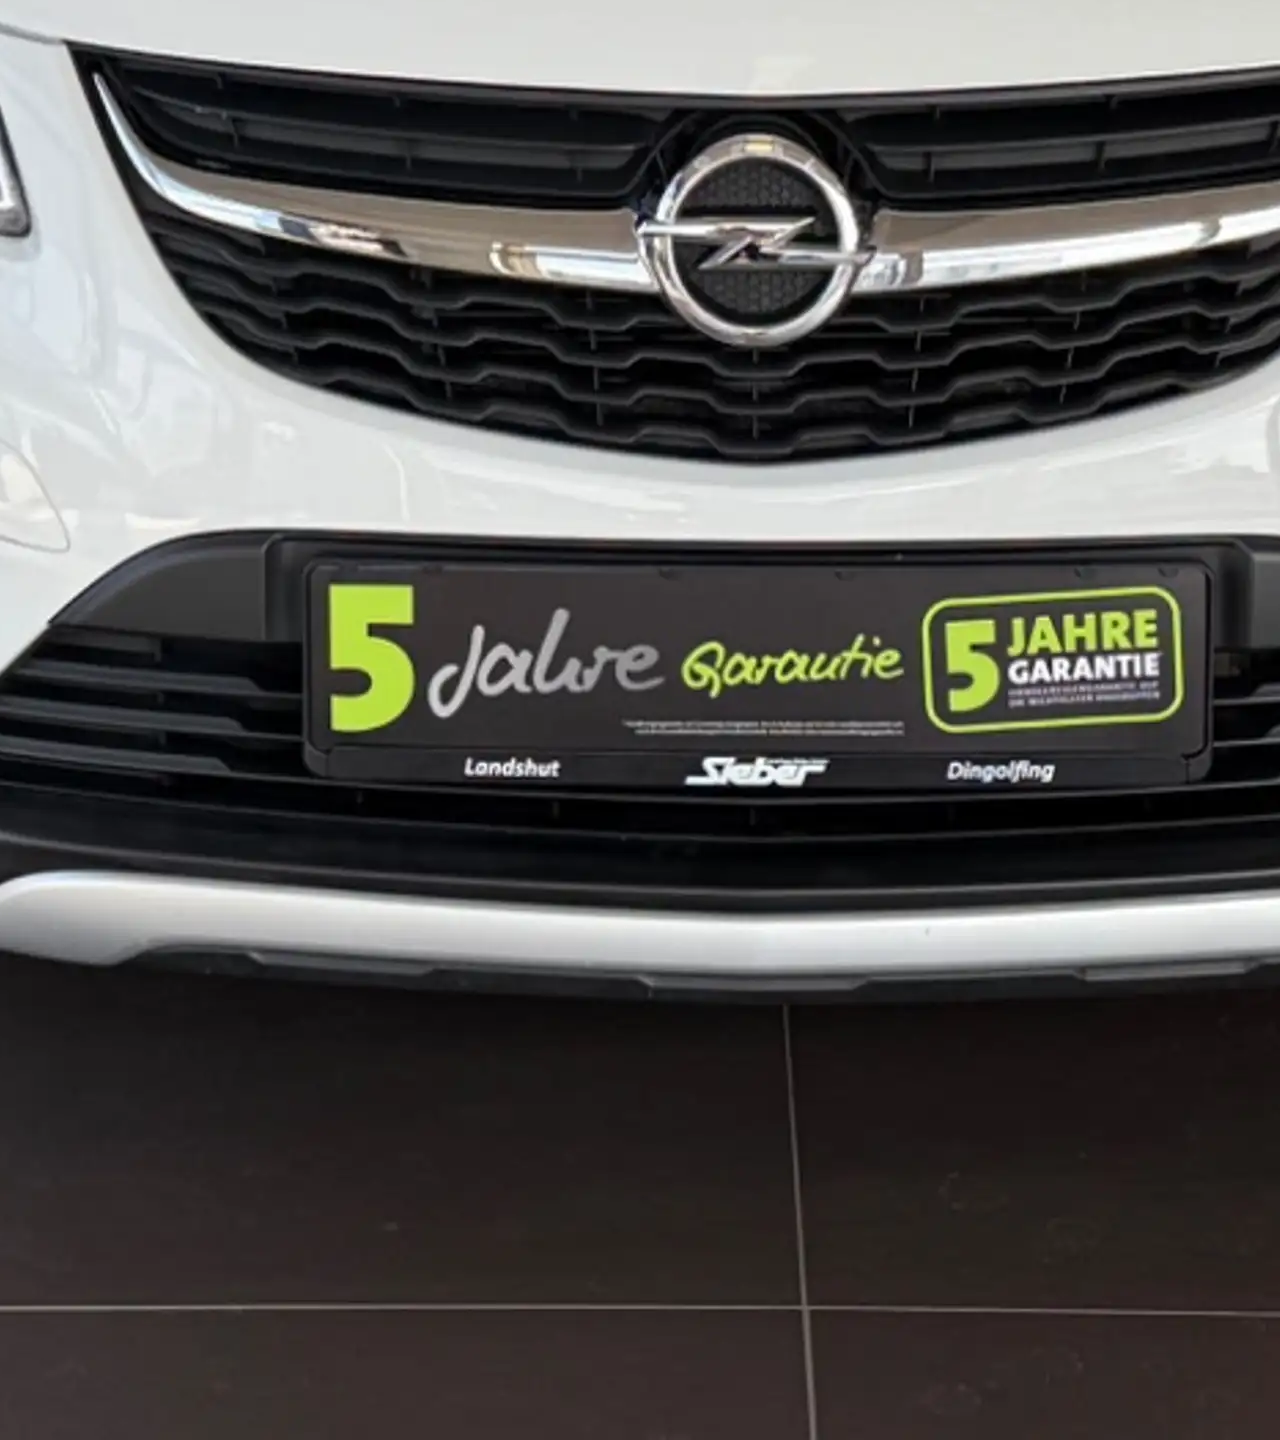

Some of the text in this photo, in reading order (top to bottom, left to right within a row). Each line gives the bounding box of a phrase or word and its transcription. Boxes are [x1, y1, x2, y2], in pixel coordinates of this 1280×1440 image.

[1007, 608, 1159, 657] JAHRE
[329, 584, 905, 733] 5 Jahre Garantie
[945, 618, 1000, 713] 5
[1007, 651, 1162, 685] GARANTIE
[464, 757, 561, 779] Landshut
[684, 756, 830, 787] Sieber
[947, 760, 1056, 783] Dingolfing
